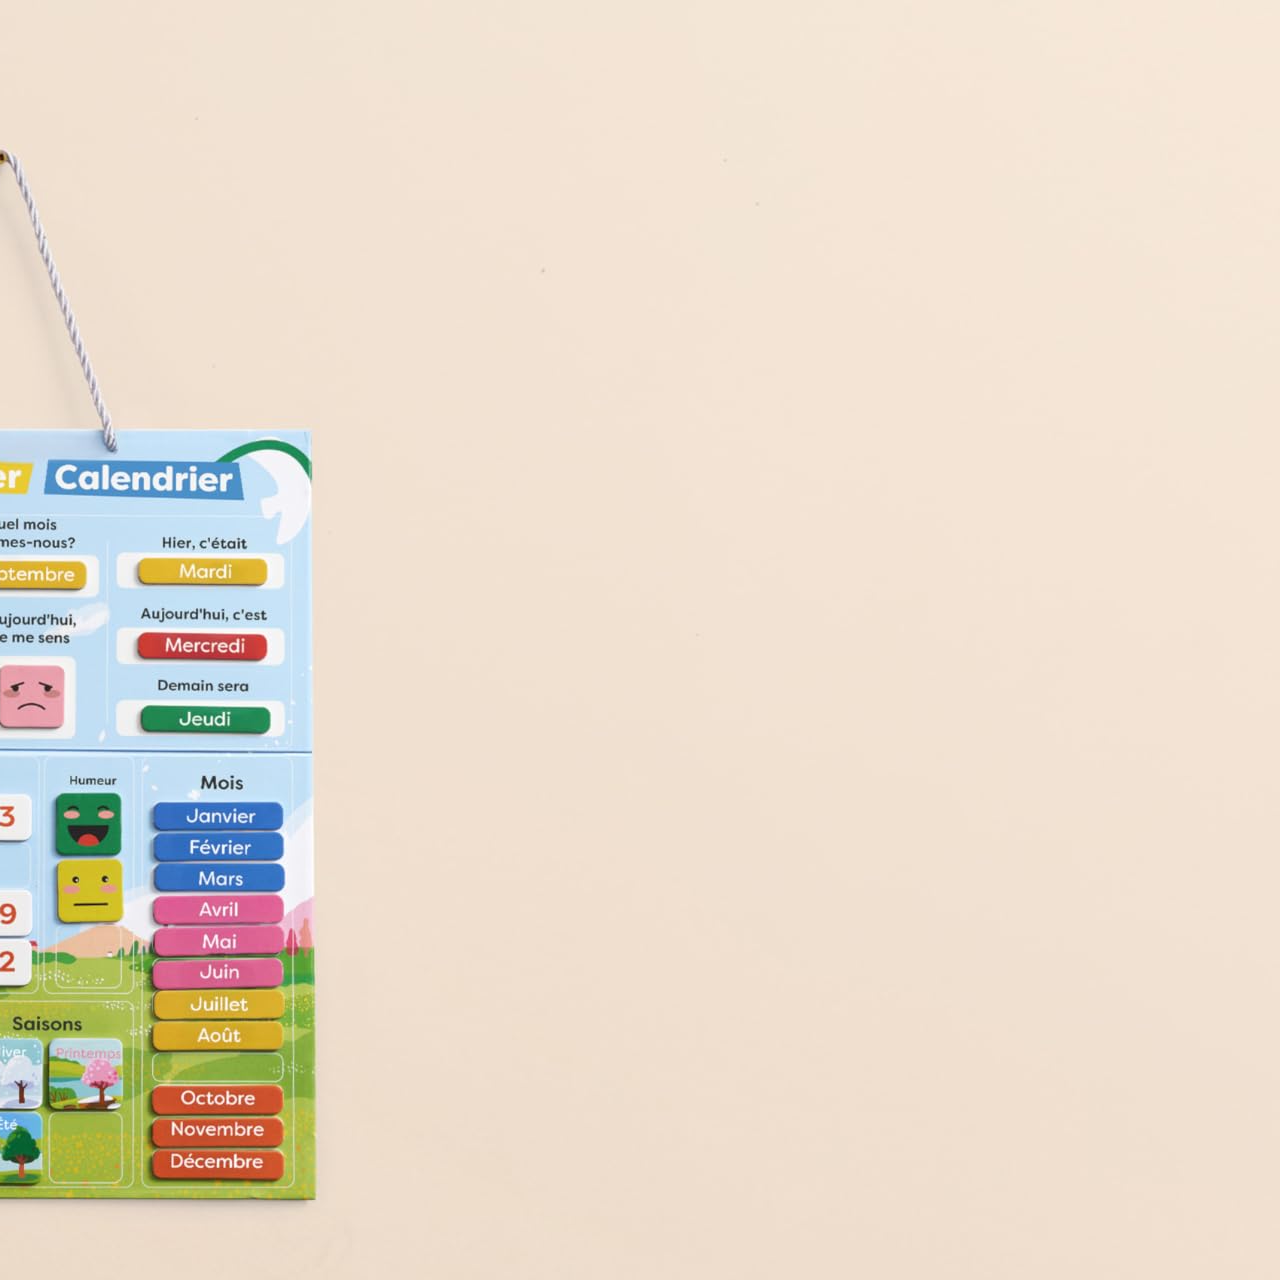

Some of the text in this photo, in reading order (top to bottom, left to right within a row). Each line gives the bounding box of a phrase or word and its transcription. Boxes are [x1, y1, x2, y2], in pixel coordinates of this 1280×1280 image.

[54, 465, 233, 494] Calendrier
[22, 519, 57, 531] mois
[161, 537, 248, 551] Hier, c'était
[179, 564, 232, 579] Mardi
[140, 608, 268, 623] Aujourd'hui, c'est
[11, 633, 34, 645] me
[37, 633, 71, 645] sens
[164, 637, 246, 654] Mercredi
[157, 680, 250, 692] Demain sera
[179, 711, 231, 727] Jeudi
[69, 776, 117, 786] Humeur
[200, 776, 244, 790] Mois
[185, 808, 256, 825] Janvier
[189, 840, 252, 856] Février
[197, 871, 244, 887] Mars
[0, 904, 17, 925] 9
[198, 901, 239, 918] Avril
[202, 933, 237, 950] Mai
[199, 965, 240, 979] Juin
[190, 995, 248, 1013] Juillet
[12, 1015, 83, 1032] Saisons
[196, 1027, 242, 1044] Août
[56, 1047, 122, 1060] Printemps
[180, 1089, 256, 1106] Octobre
[170, 1120, 264, 1137] Novembre
[170, 1152, 263, 1170] Décembre
